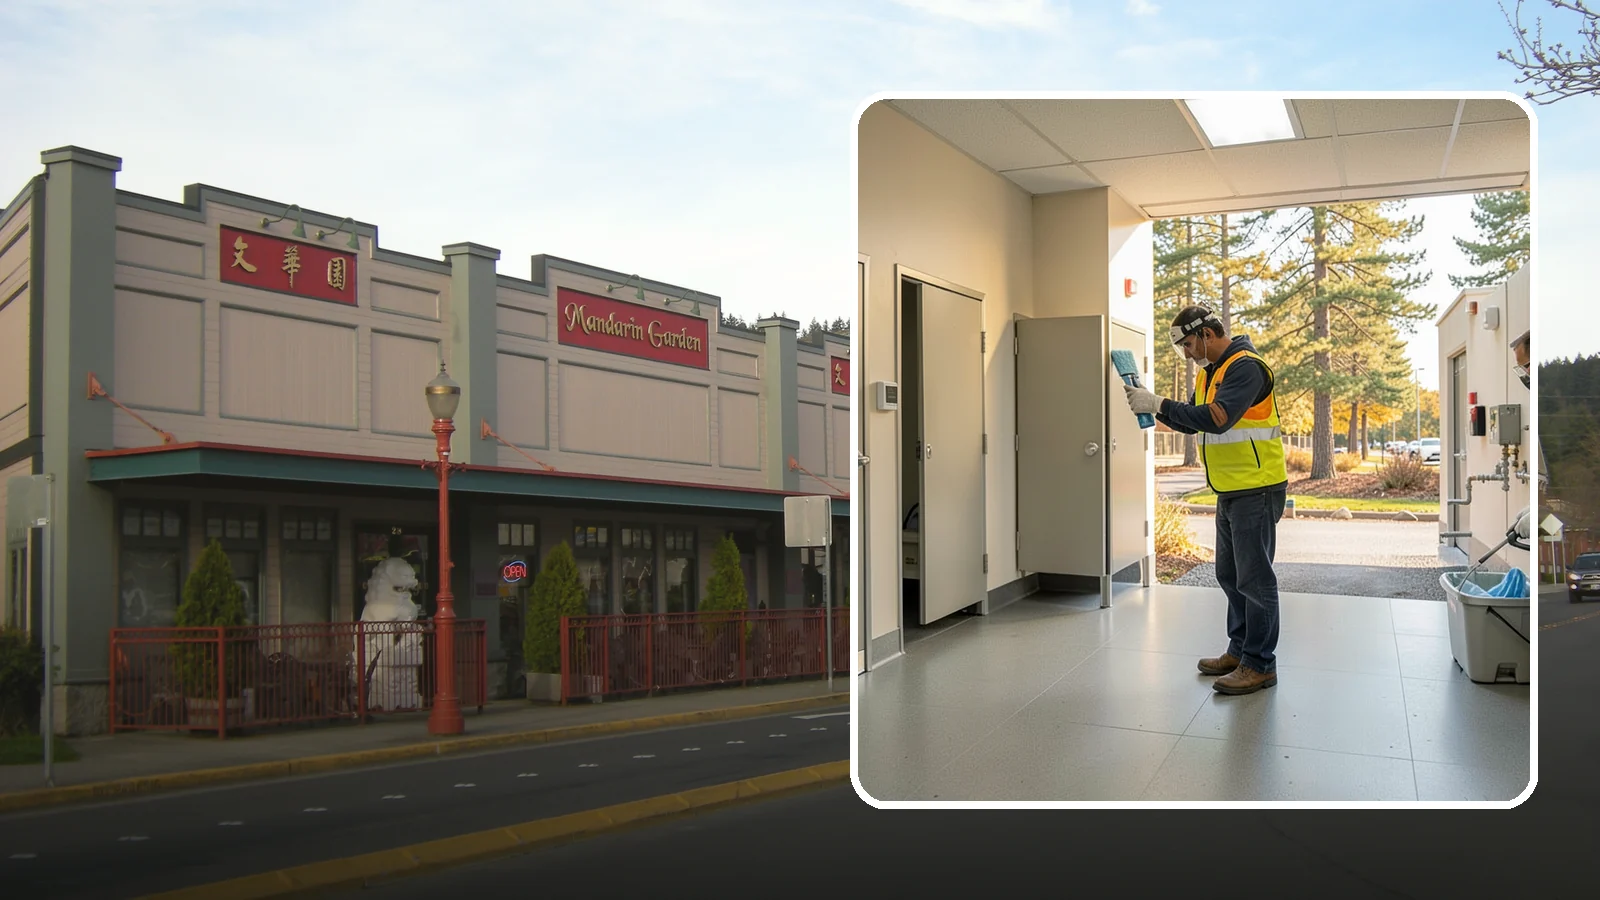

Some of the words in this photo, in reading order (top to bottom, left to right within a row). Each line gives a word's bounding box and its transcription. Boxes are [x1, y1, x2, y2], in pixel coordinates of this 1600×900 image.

[231, 235, 346, 291] 文華園
[564, 302, 644, 342] Mandarin
[648, 320, 702, 352] Garden
[503, 565, 527, 578] OPEN
